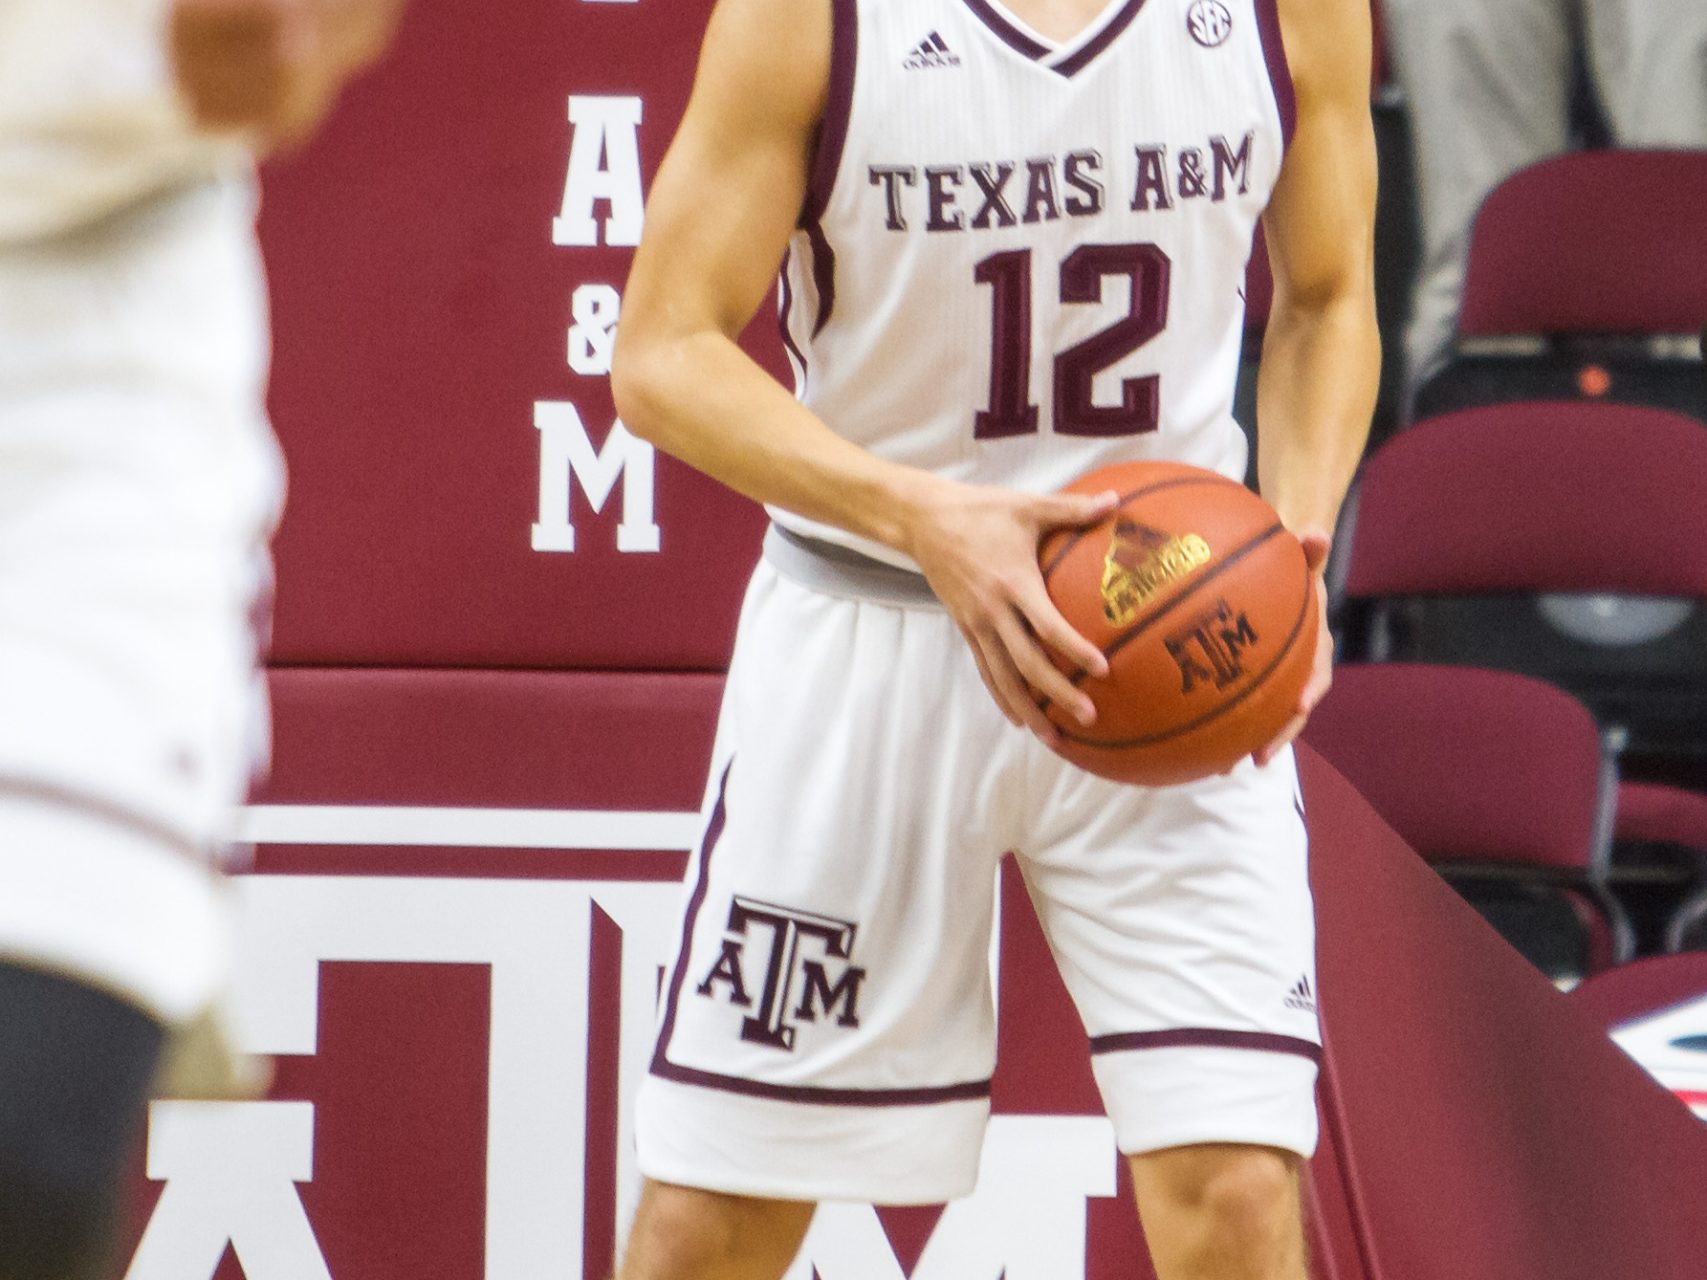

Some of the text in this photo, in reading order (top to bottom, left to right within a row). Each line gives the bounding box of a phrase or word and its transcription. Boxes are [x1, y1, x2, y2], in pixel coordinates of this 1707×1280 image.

[868, 129, 1254, 231] TEXAS A&M
[973, 242, 1171, 440] 12
